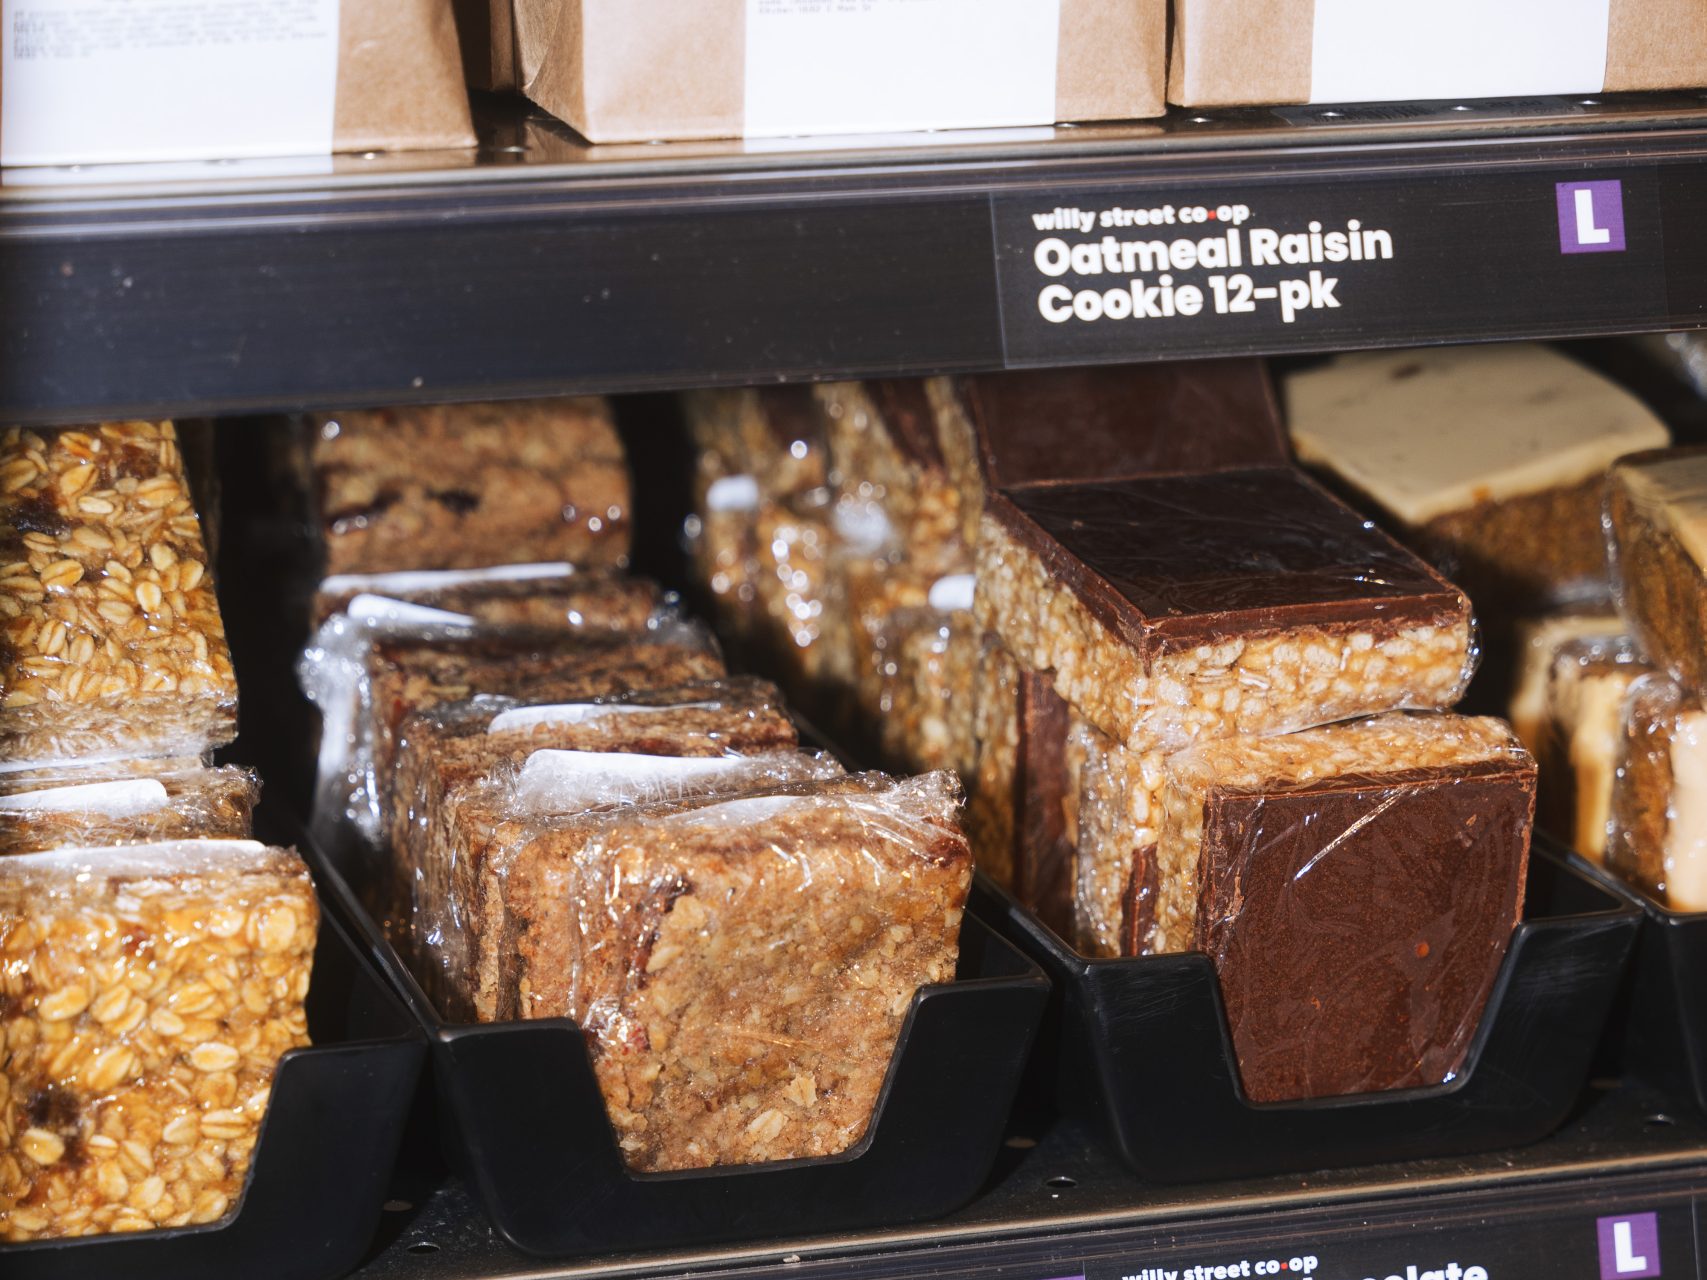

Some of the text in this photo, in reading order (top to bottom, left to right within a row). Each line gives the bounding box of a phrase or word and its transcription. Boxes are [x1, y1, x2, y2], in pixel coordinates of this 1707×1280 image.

[1032, 207, 1096, 233] willy
[1100, 205, 1176, 227] street
[1575, 190, 1609, 244] L
[1034, 219, 1393, 276] Oatmeal Raisin
[1038, 270, 1340, 323] Cookie 12-pk
[1614, 1222, 1647, 1273] L
